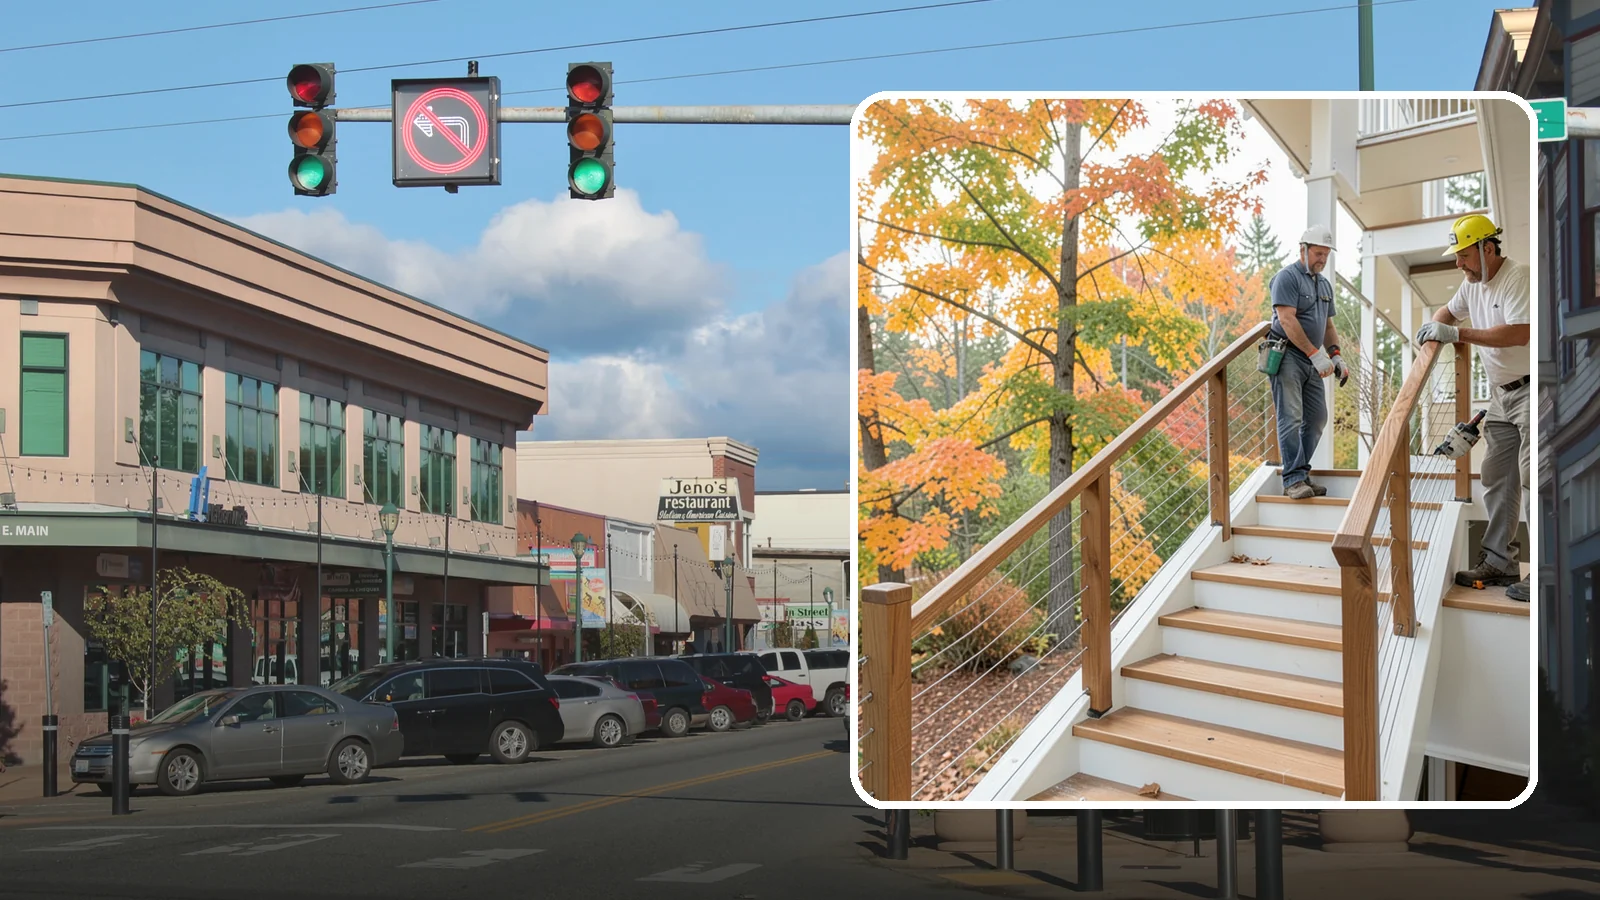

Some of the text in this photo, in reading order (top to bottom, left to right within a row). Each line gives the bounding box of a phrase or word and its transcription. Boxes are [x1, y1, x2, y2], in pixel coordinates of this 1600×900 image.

[669, 479, 728, 495] Jeno's
[665, 496, 731, 509] restaurant
[658, 509, 682, 519] Italian
[685, 509, 714, 519] American
[715, 509, 738, 519] Cuisine
[2, 525, 49, 536] E. MAIN
[797, 607, 829, 617] Street
